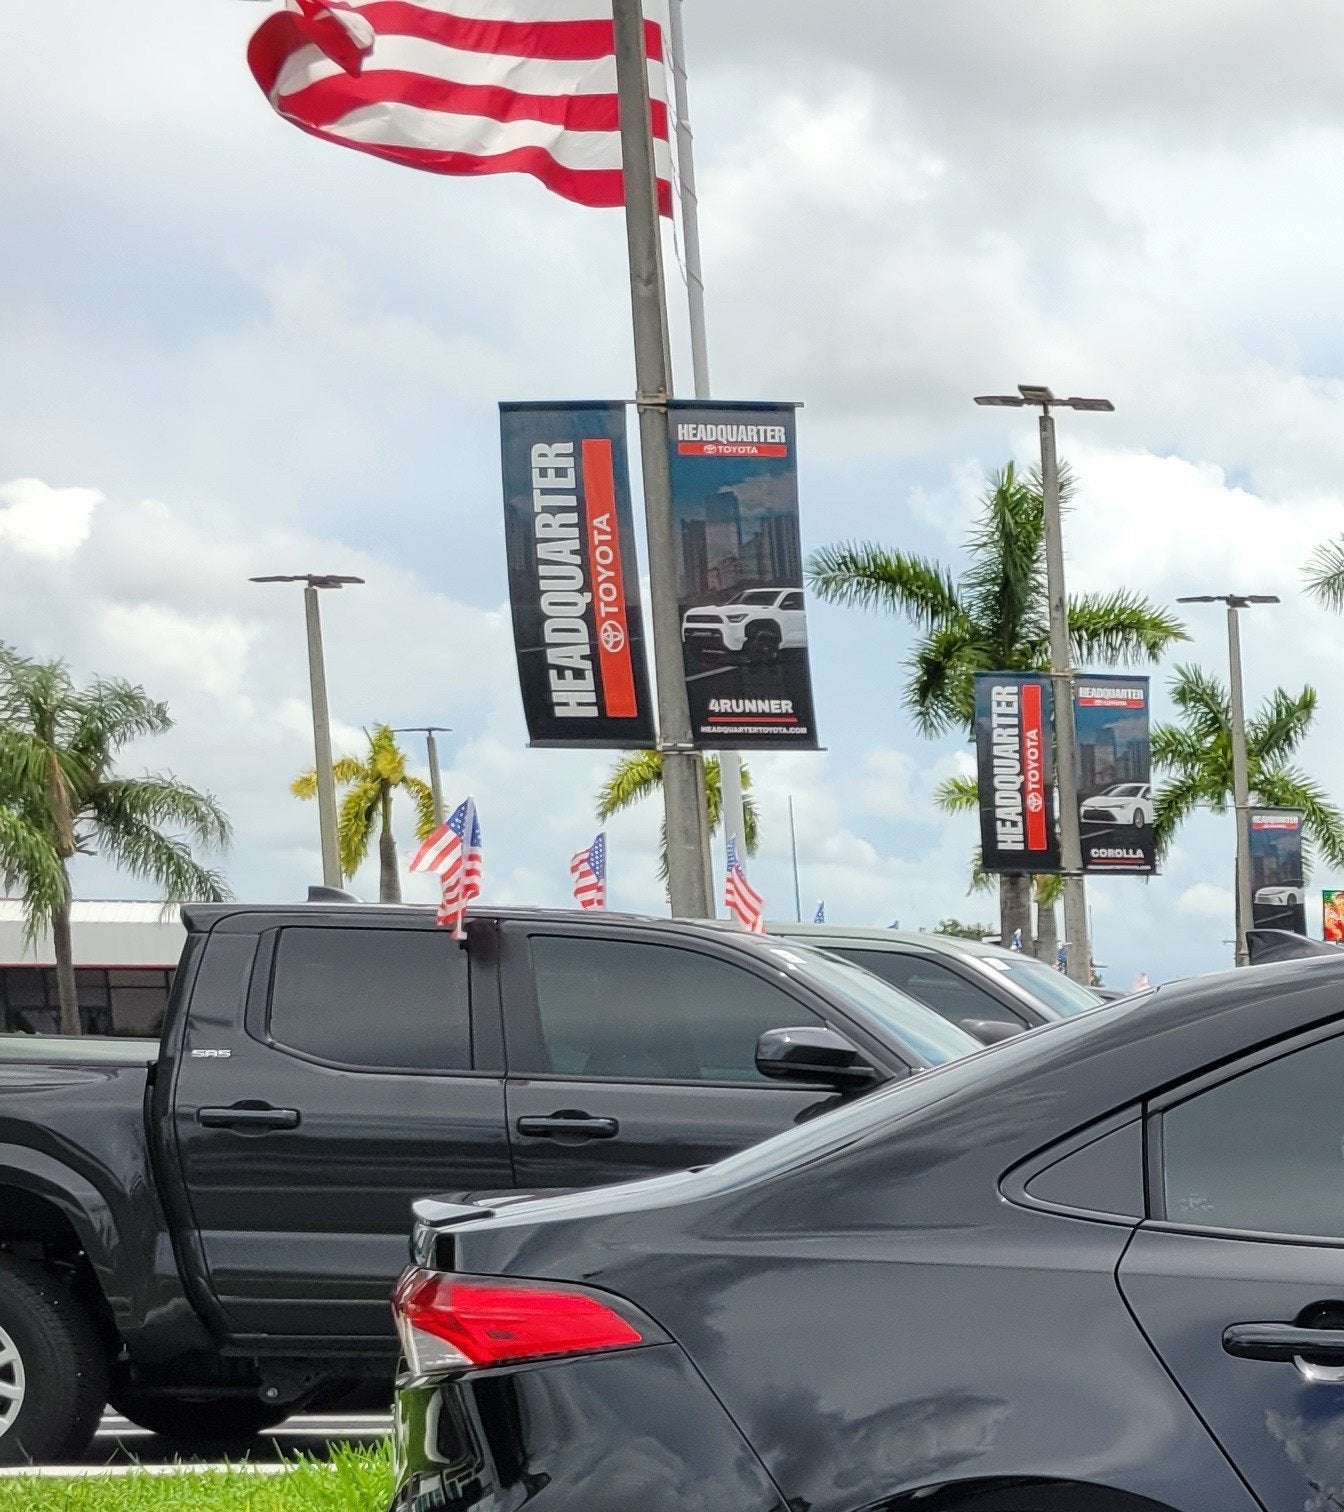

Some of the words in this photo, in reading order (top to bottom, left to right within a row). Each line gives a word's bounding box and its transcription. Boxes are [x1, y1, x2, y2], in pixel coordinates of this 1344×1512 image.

[677, 423, 786, 444] HEADQUARTER
[718, 445, 759, 454] TOYOTA
[531, 442, 600, 718] HEADQUARTER
[593, 513, 618, 617] TOYOTA
[708, 698, 794, 714] 4RUNNER
[991, 685, 1025, 850] HEADQUARTER
[1026, 729, 1041, 790] TOYOTA
[1090, 848, 1145, 859] COROLLA
